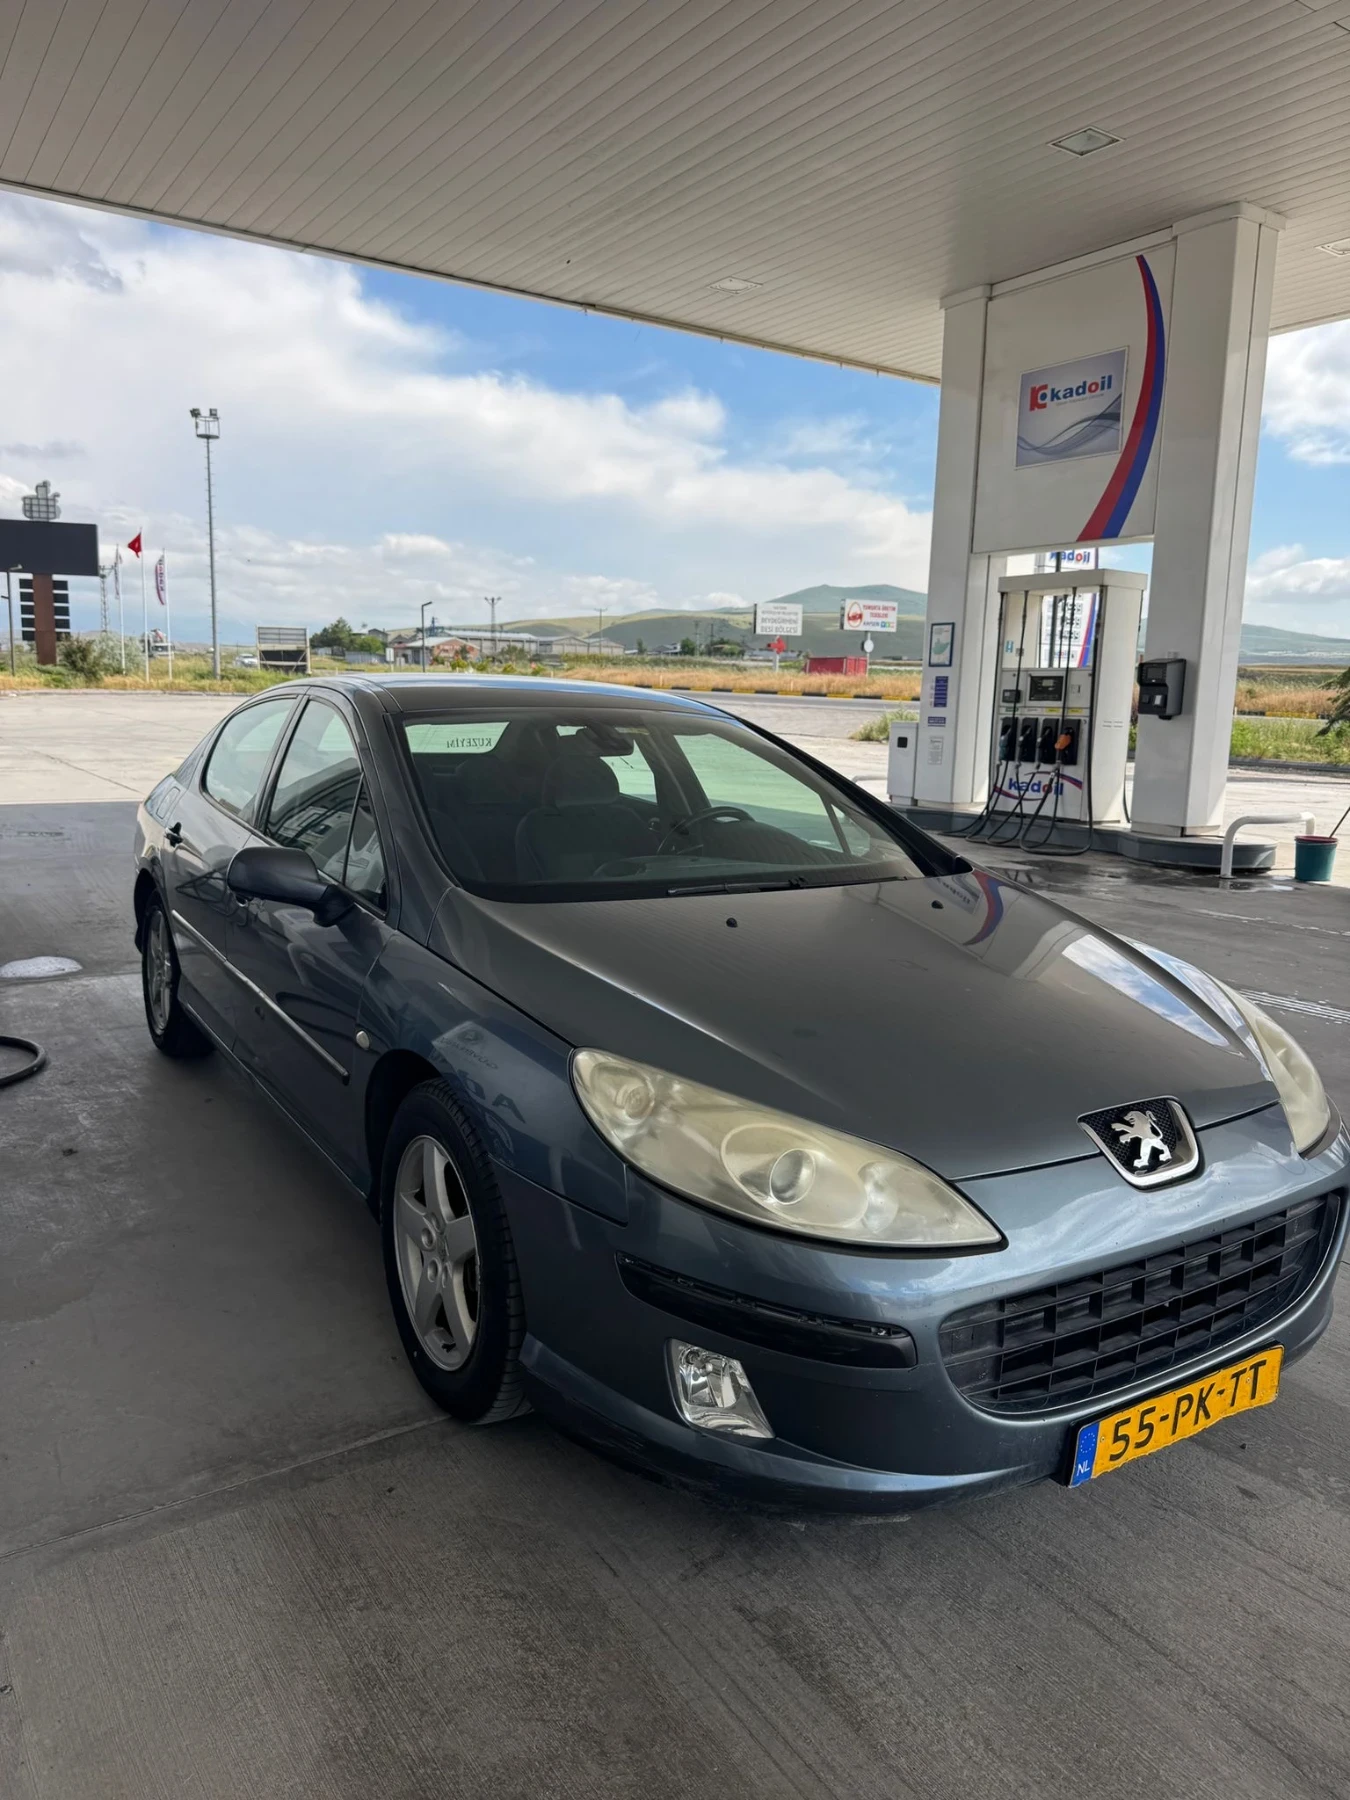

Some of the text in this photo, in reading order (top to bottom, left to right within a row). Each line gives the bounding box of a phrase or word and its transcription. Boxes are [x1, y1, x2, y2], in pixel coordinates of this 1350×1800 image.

[1050, 374, 1113, 402] kadoil
[1109, 1359, 1267, 1462] 55-PK-TT
[1077, 1460, 1090, 1476] NL
